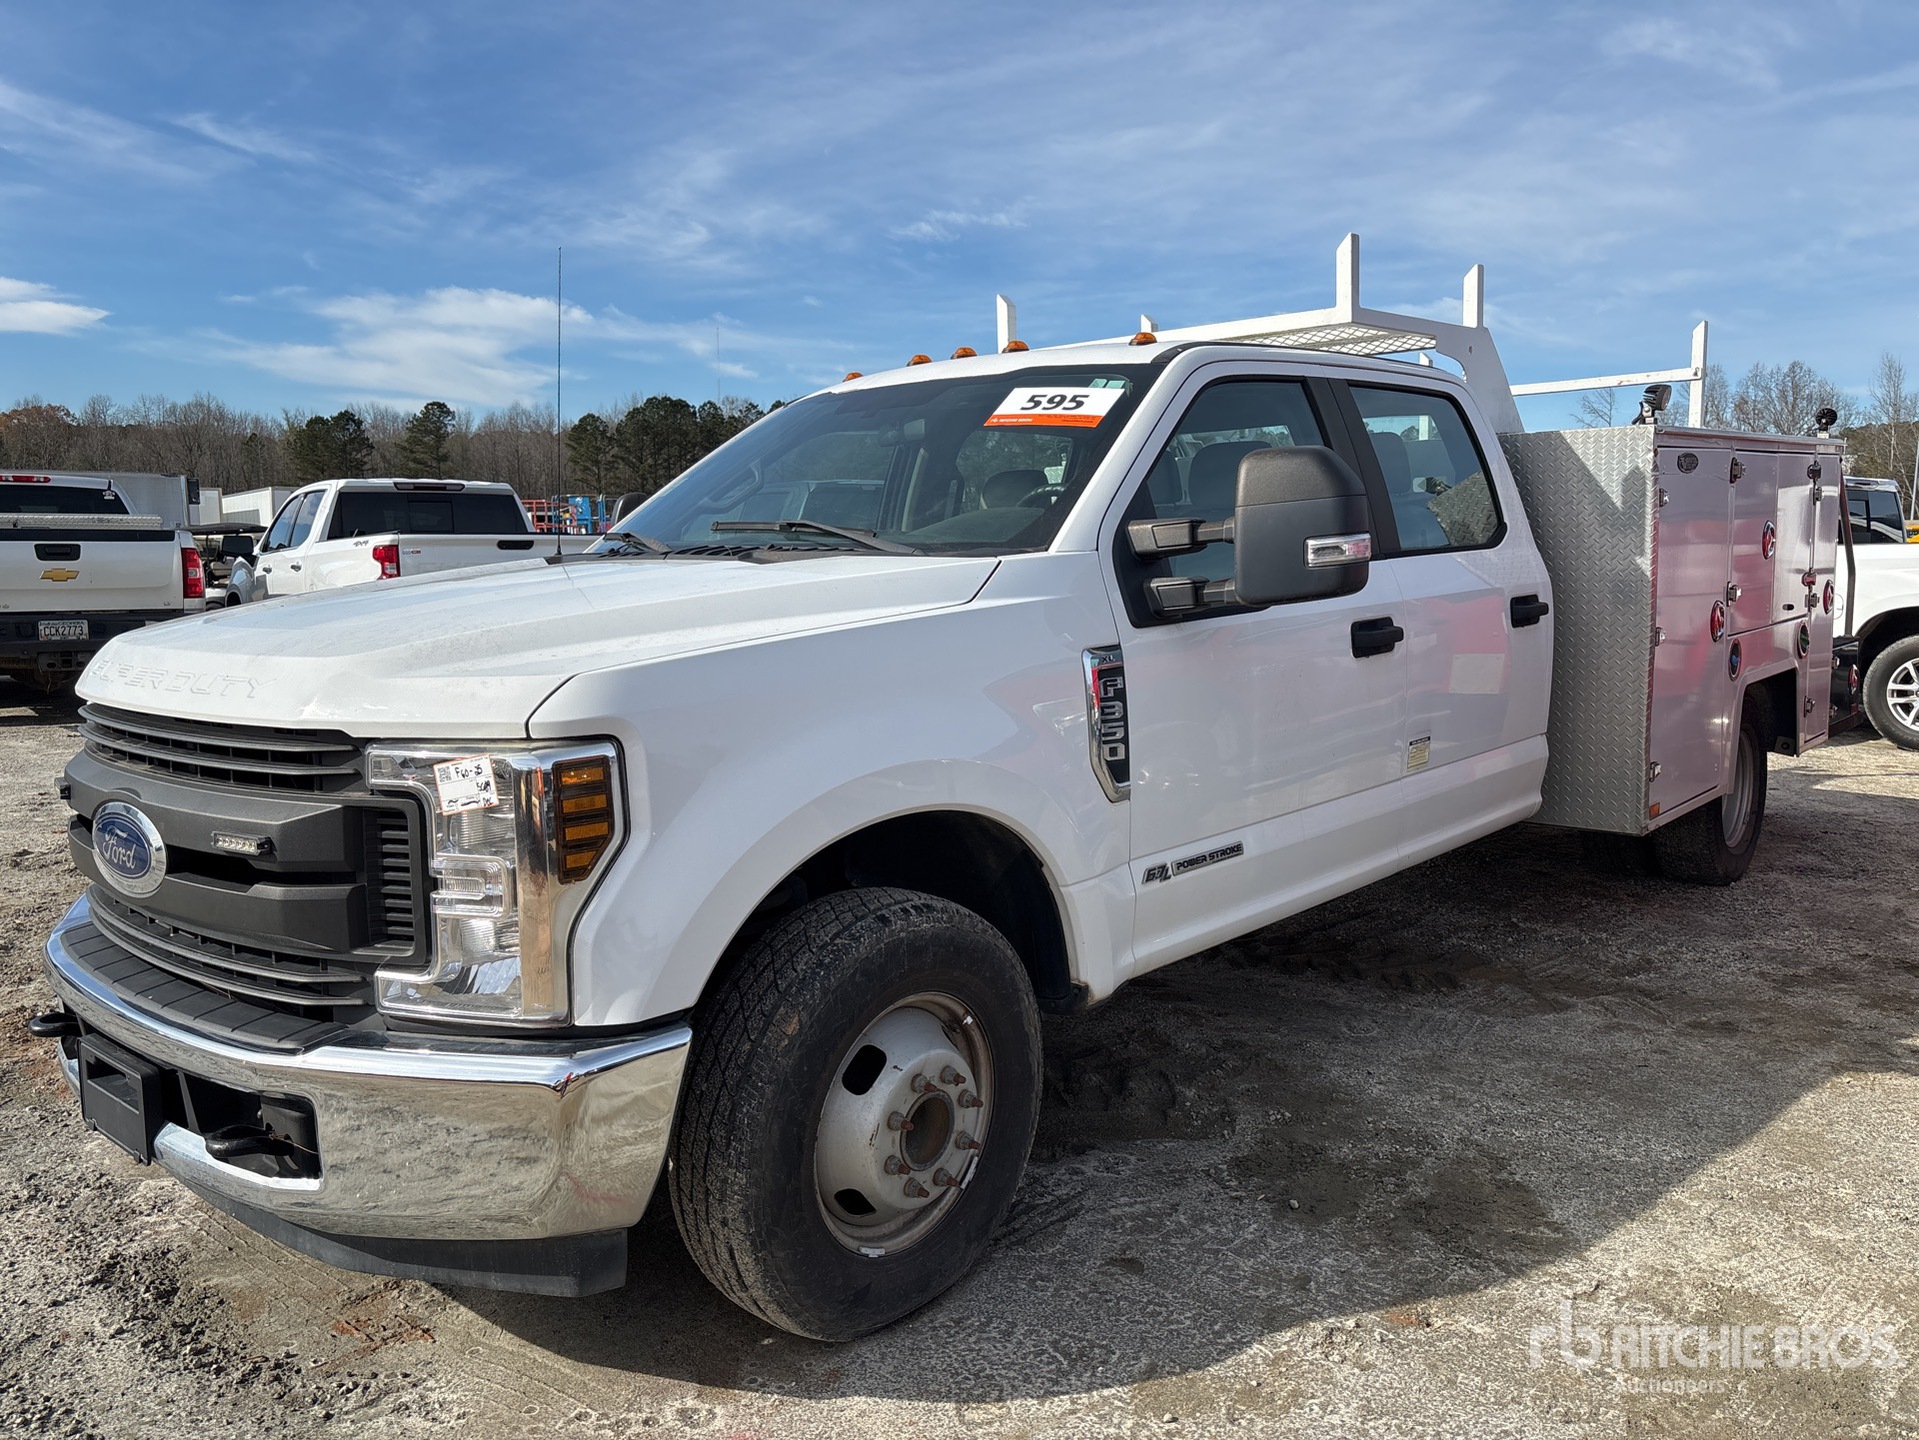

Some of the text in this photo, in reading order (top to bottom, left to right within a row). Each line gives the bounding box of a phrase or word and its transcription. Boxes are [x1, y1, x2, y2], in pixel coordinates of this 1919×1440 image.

[1020, 394, 1090, 411] 595
[43, 626, 84, 637] CCK2773
[165, 671, 279, 699] DUTY
[1100, 677, 1126, 761] F350
[102, 825, 137, 870] Ford
[1176, 854, 1208, 871] POWER
[1208, 843, 1242, 861] STROKE
